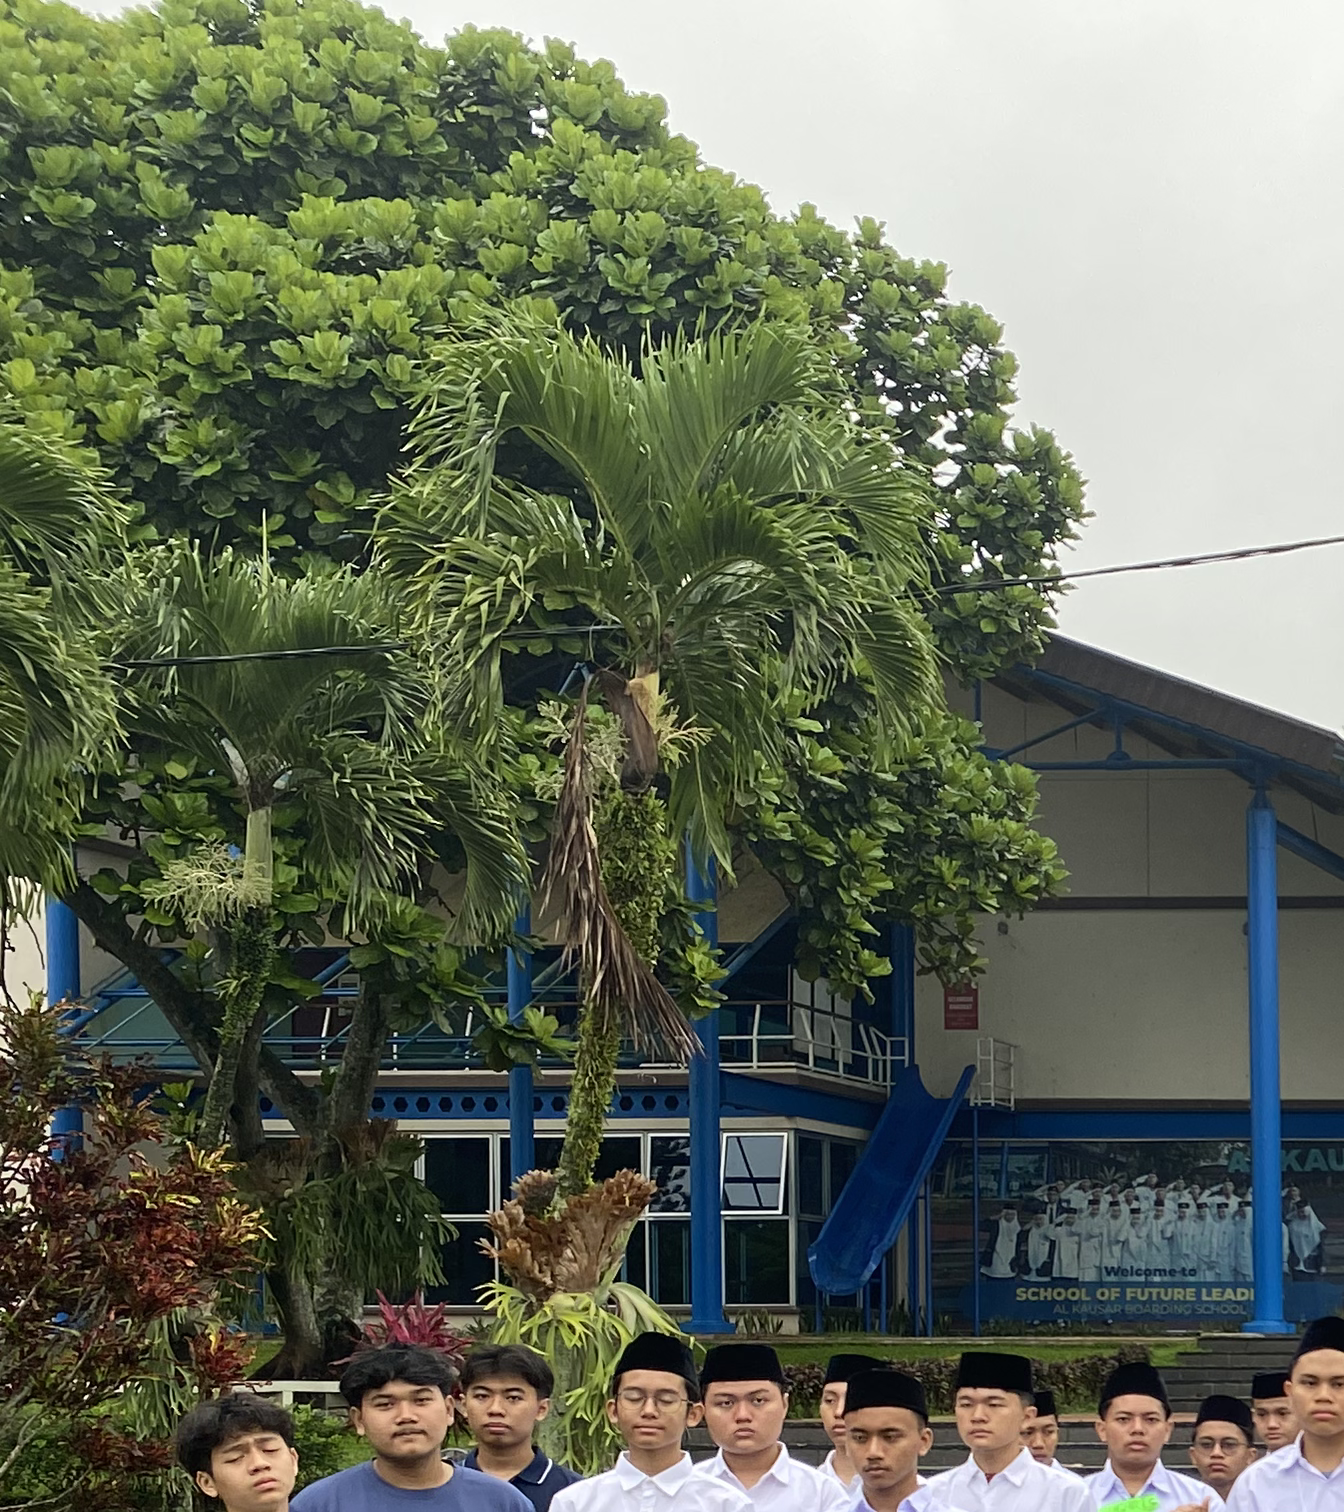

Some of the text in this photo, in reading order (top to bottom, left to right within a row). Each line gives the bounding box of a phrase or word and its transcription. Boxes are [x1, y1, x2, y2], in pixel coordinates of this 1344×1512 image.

[1104, 1266, 1197, 1277] Welcome to
[1016, 1288, 1090, 1301] SCHOOL
[1096, 1288, 1121, 1300] OF
[1126, 1288, 1197, 1301] FUTURE
[1053, 1304, 1247, 1315] AL KAUSAR BOARDING SCHOOL
